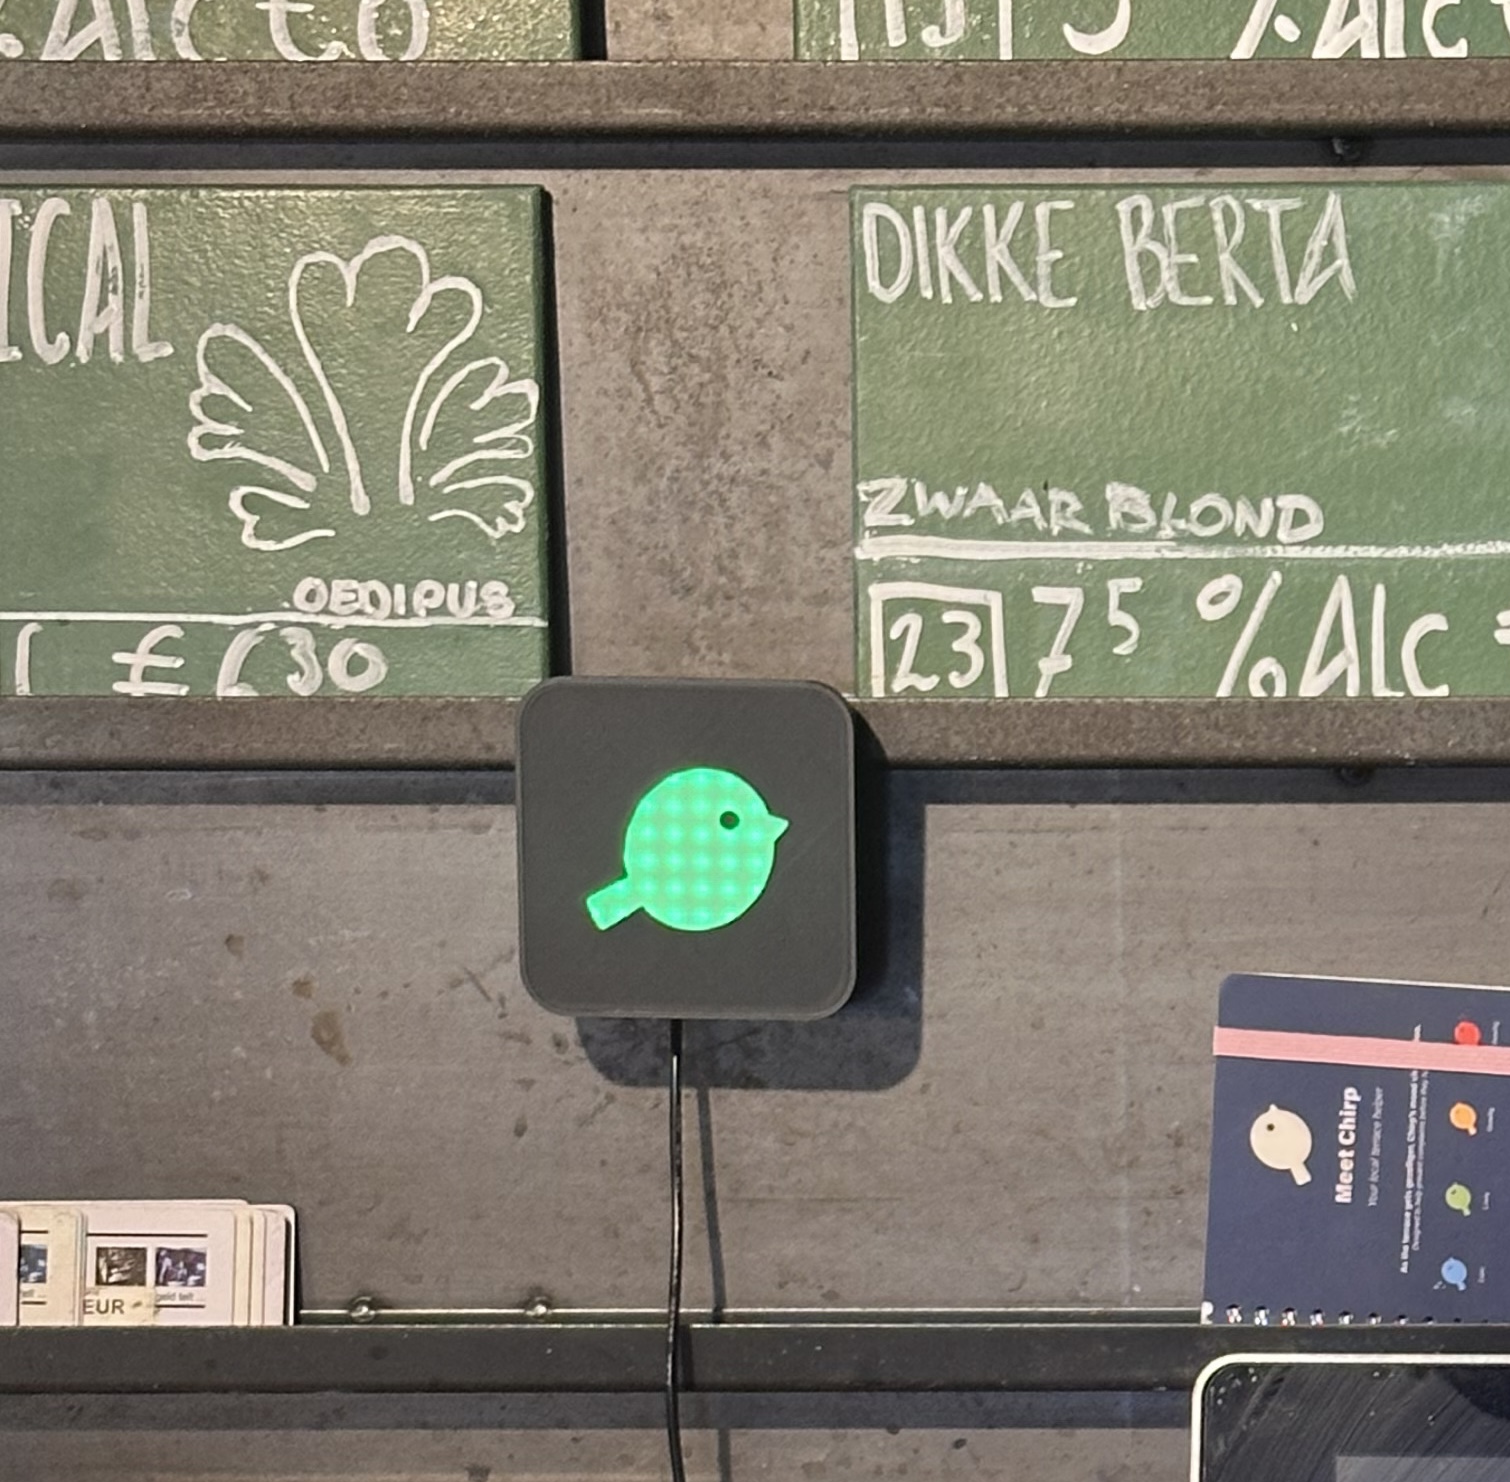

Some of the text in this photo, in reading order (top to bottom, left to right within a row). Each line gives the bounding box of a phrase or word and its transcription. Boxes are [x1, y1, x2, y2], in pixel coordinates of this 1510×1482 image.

[864, 192, 1357, 308] DIKKE BERTA
[858, 478, 1324, 540] ZWAAR BLOND
[293, 577, 516, 620] OEDIPUS
[888, 610, 985, 692] 23
[1335, 1086, 1362, 1203] Meet Chirp
[83, 1298, 125, 1315] EUR
